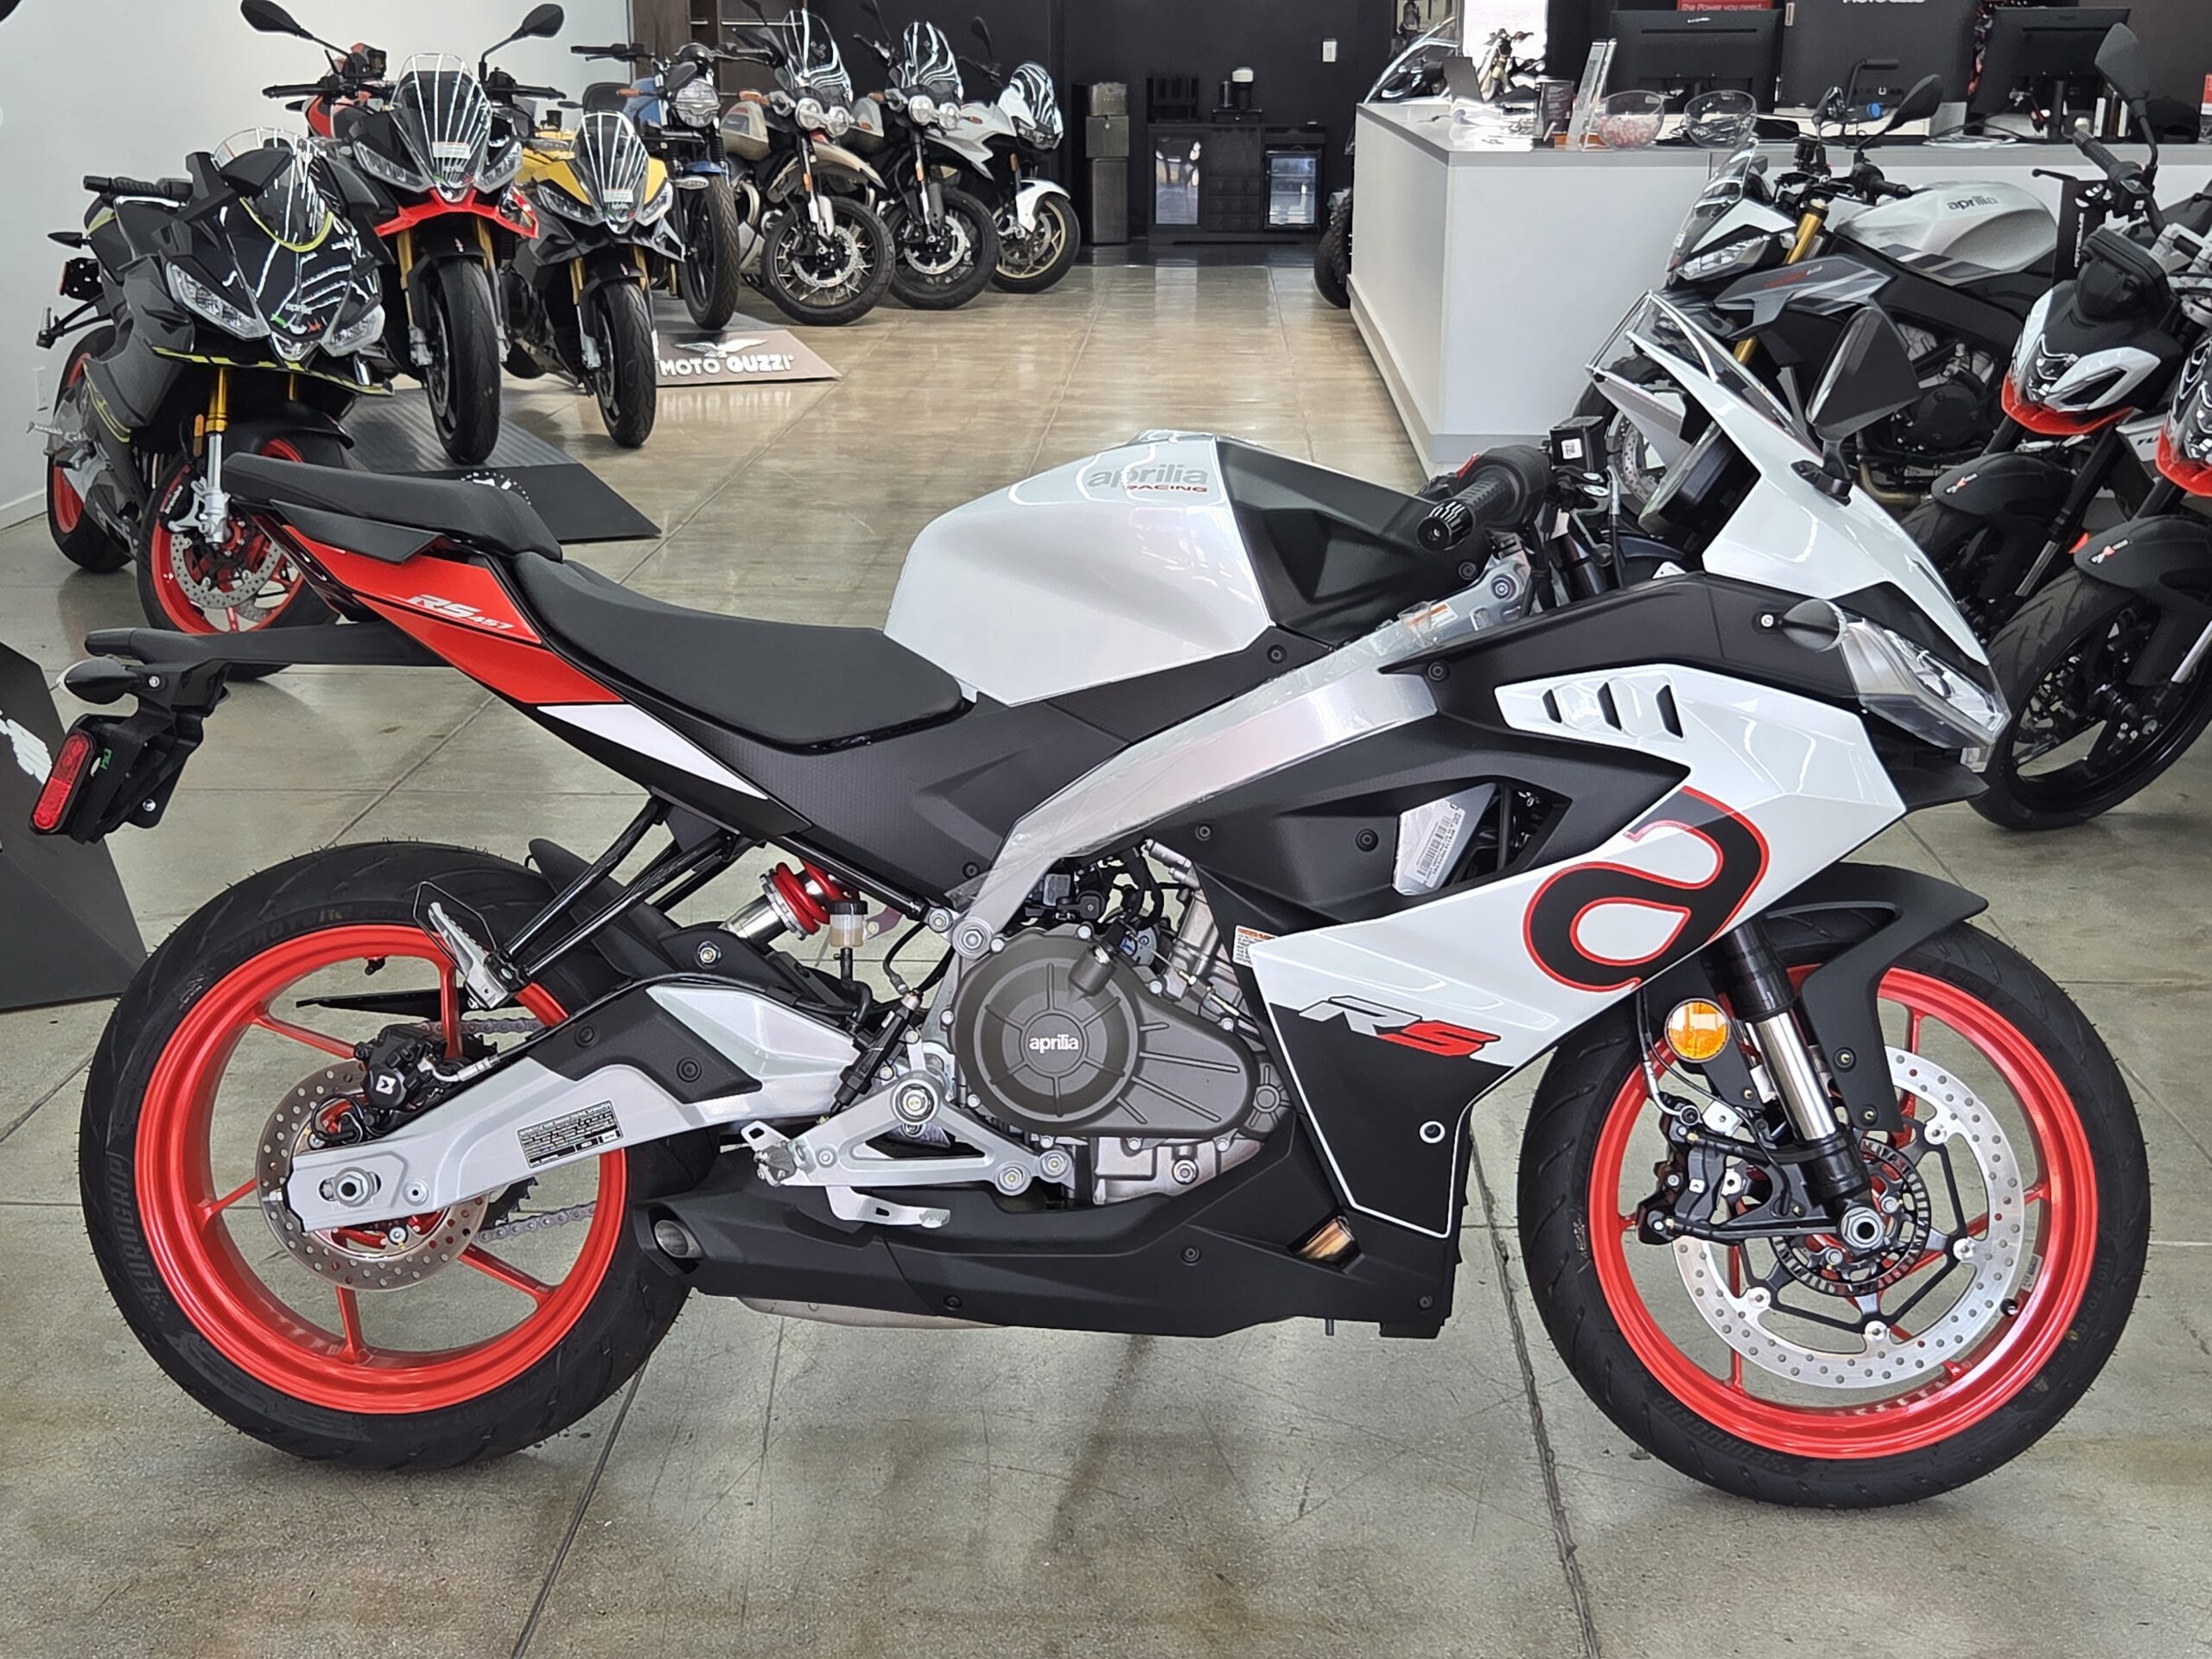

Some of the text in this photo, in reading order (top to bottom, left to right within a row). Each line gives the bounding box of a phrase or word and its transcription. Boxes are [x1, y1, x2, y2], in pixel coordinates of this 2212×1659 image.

[1946, 195, 1999, 210] aprilia
[658, 354, 794, 376] MOTO GUZZI
[1087, 464, 1208, 488] aprilia
[407, 594, 515, 629] RS 457
[1298, 995, 1502, 1057] RS
[1028, 1033, 1079, 1053] aprilia
[107, 1158, 162, 1294] EUROGRIP
